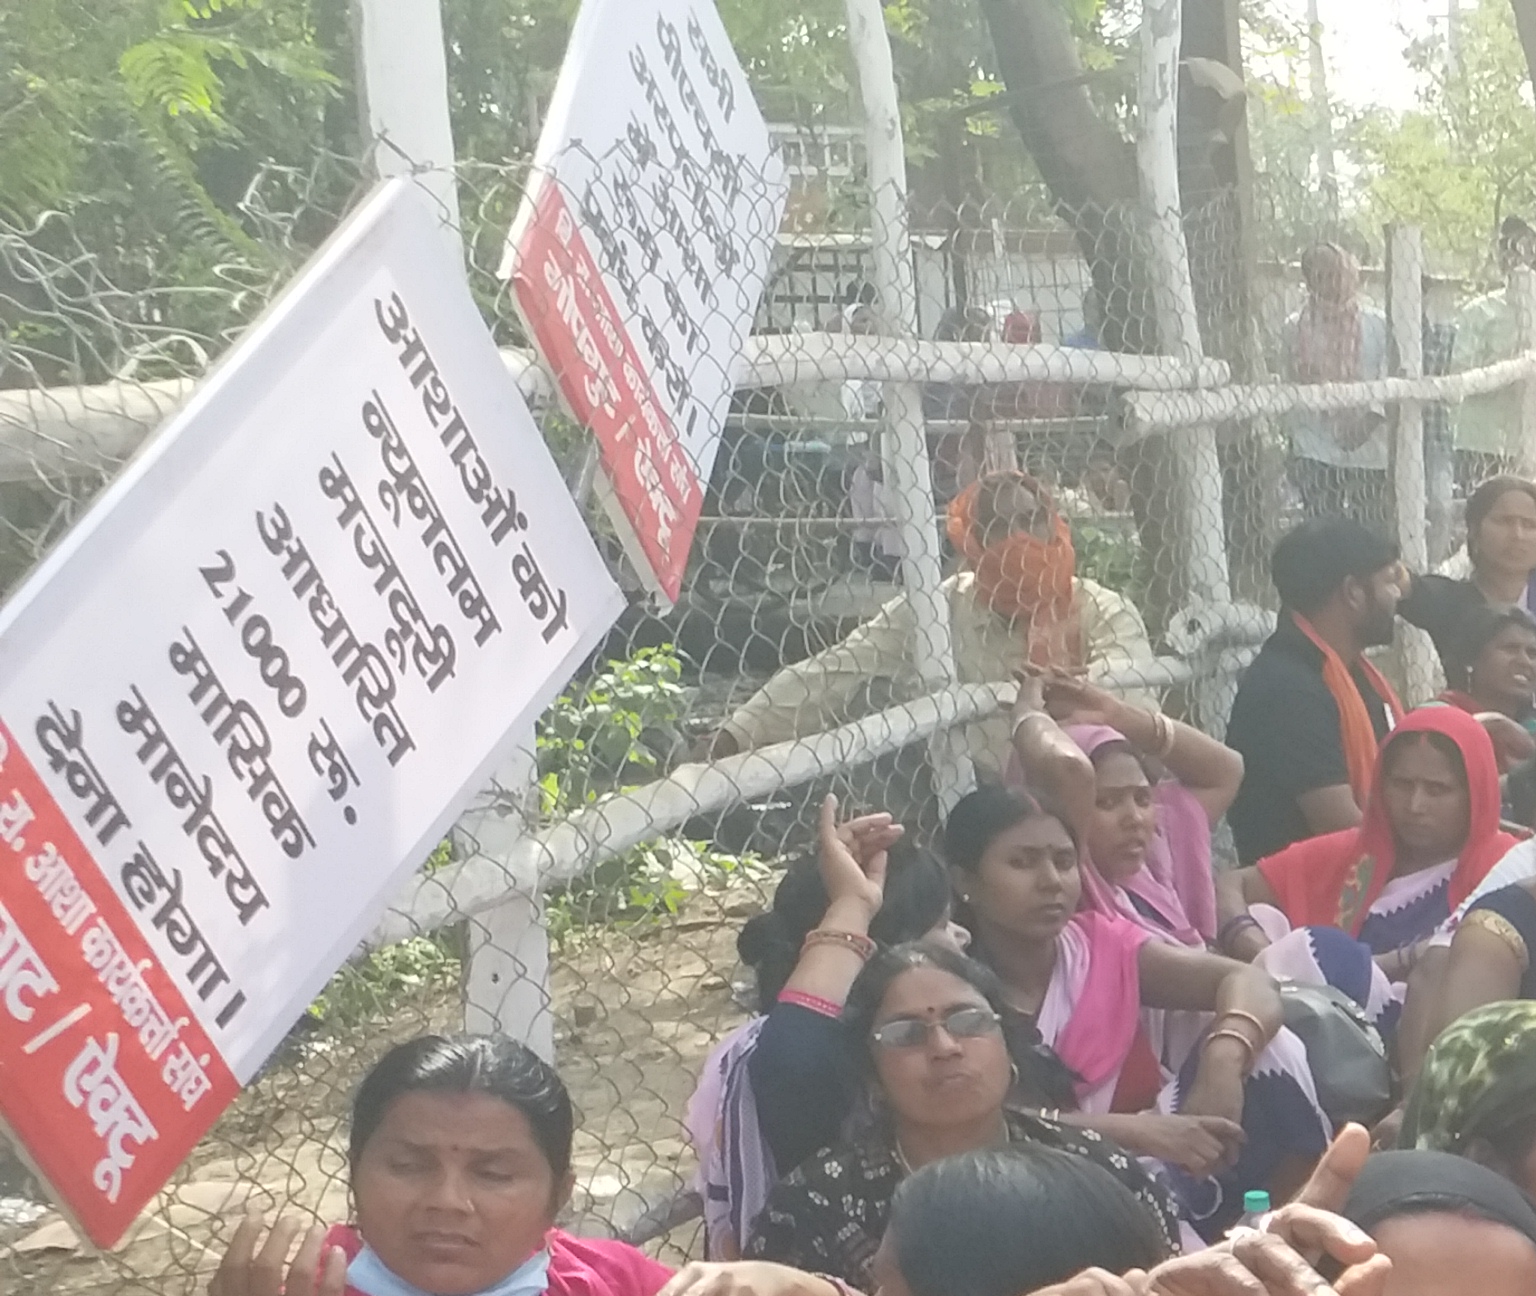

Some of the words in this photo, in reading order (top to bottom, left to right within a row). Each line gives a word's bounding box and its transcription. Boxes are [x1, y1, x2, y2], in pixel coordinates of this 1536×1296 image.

[687, 7, 736, 124] सभी
[319, 454, 455, 691] मजदूरी
[363, 391, 501, 646] न्यूनतम
[375, 294, 527, 544] आशाओं
[512, 542, 567, 643] को
[169, 628, 315, 858] मासिक
[200, 551, 306, 717] 21000
[257, 504, 415, 765] आधारित
[36, 702, 131, 845] देना
[25, 842, 96, 934] आशा
[162, 1042, 211, 1110] संघ
[64, 1033, 157, 1201] ऐक्टू
